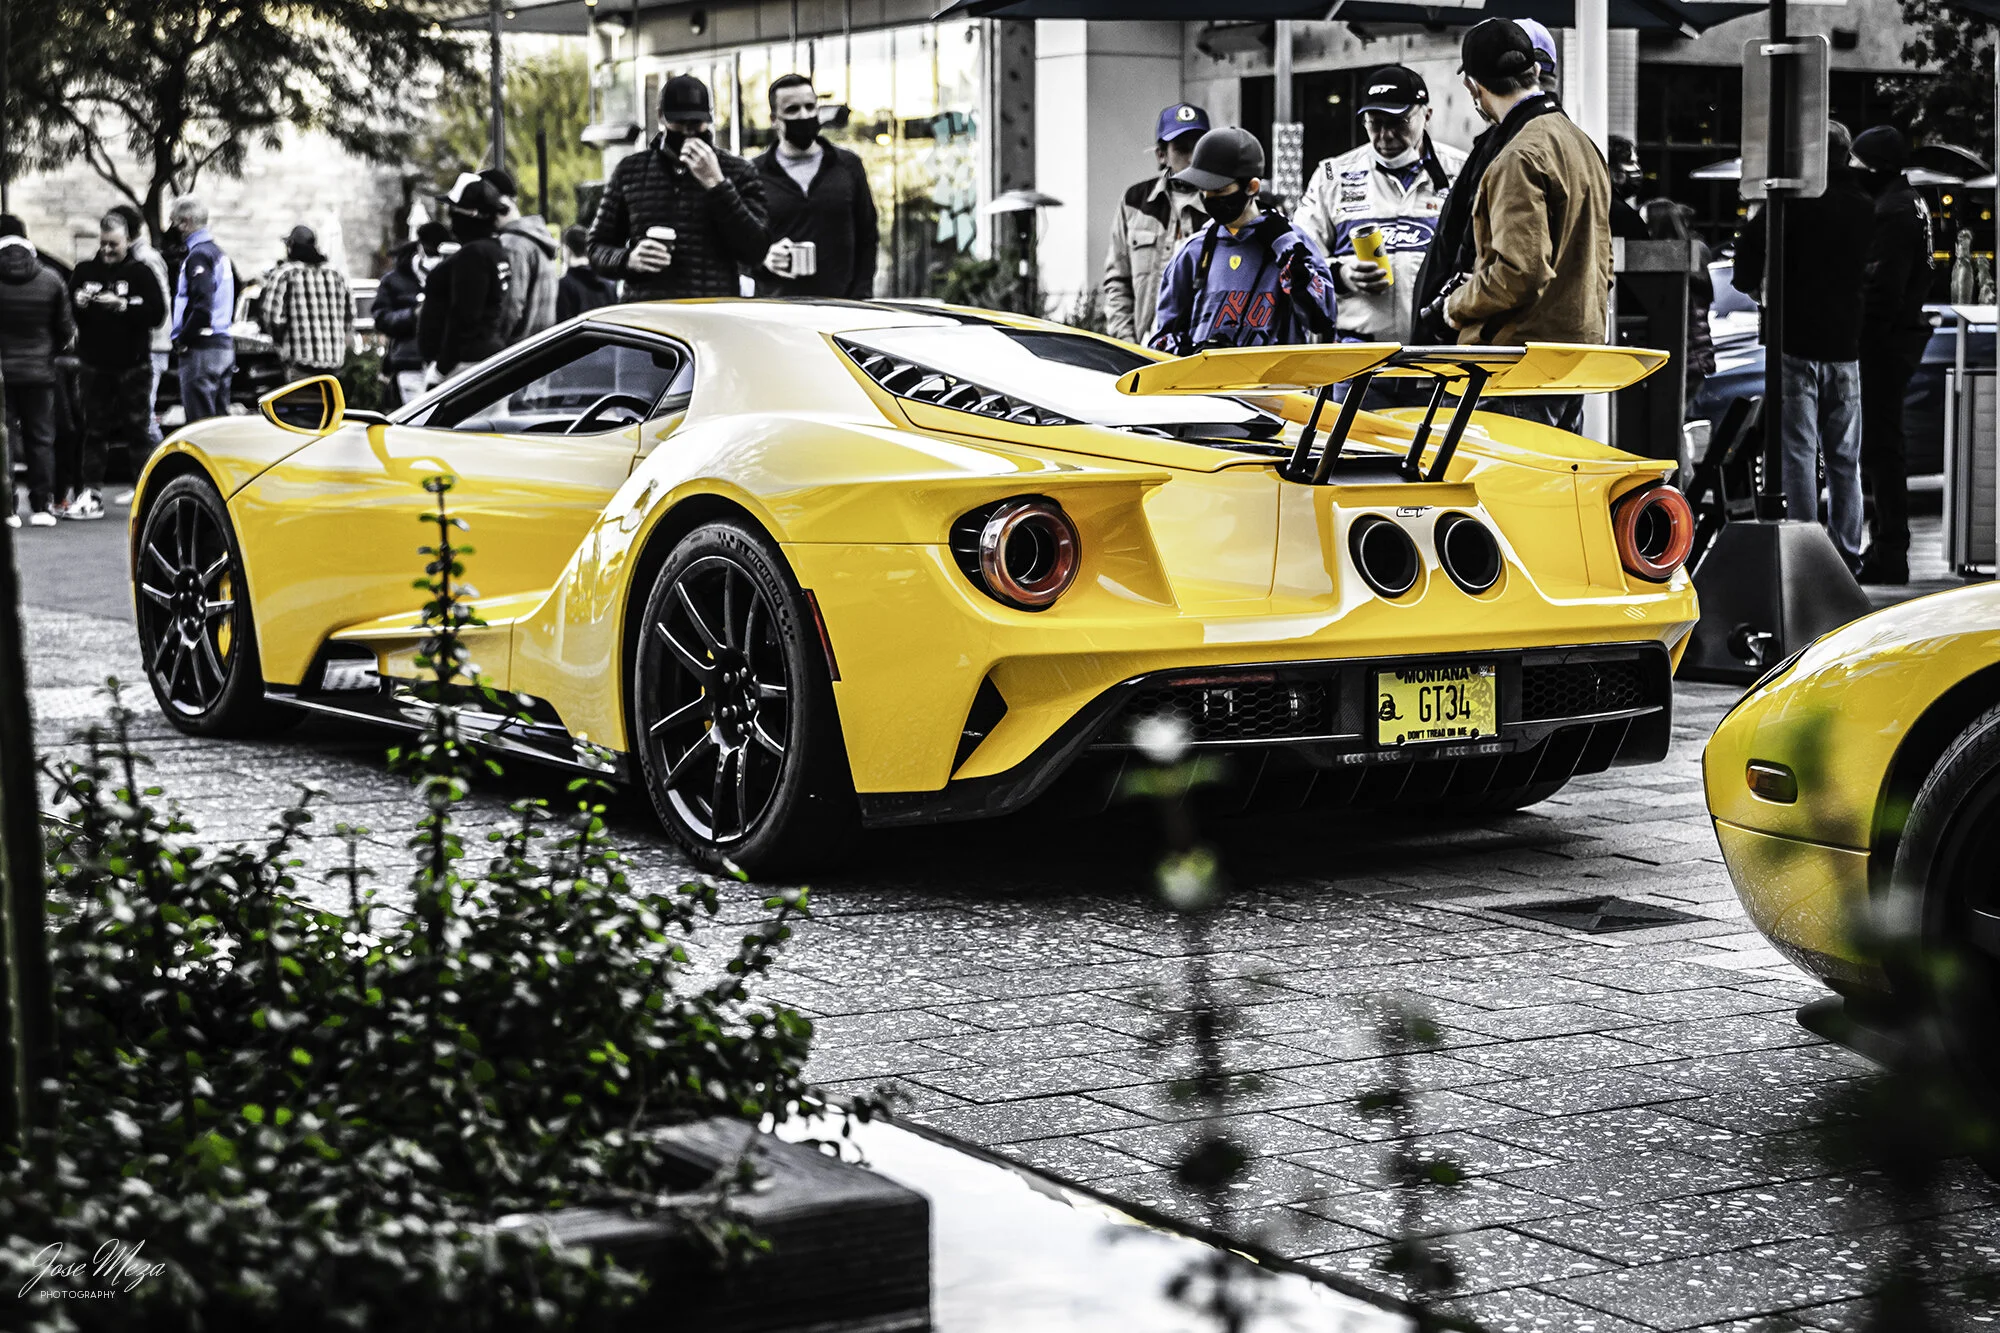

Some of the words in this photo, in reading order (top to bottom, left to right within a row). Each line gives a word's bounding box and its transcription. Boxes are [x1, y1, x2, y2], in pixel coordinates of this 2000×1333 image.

[1380, 225, 1421, 245] Ford
[1396, 505, 1433, 518] GT
[746, 549, 783, 605] MICHELIN
[1404, 667, 1469, 684] MONTANA
[1419, 684, 1471, 722] GT34
[1407, 730, 1425, 740] DON'T
[1427, 728, 1446, 738] TREAD
[1447, 728, 1456, 736] ON
[1458, 727, 1467, 735] ME
